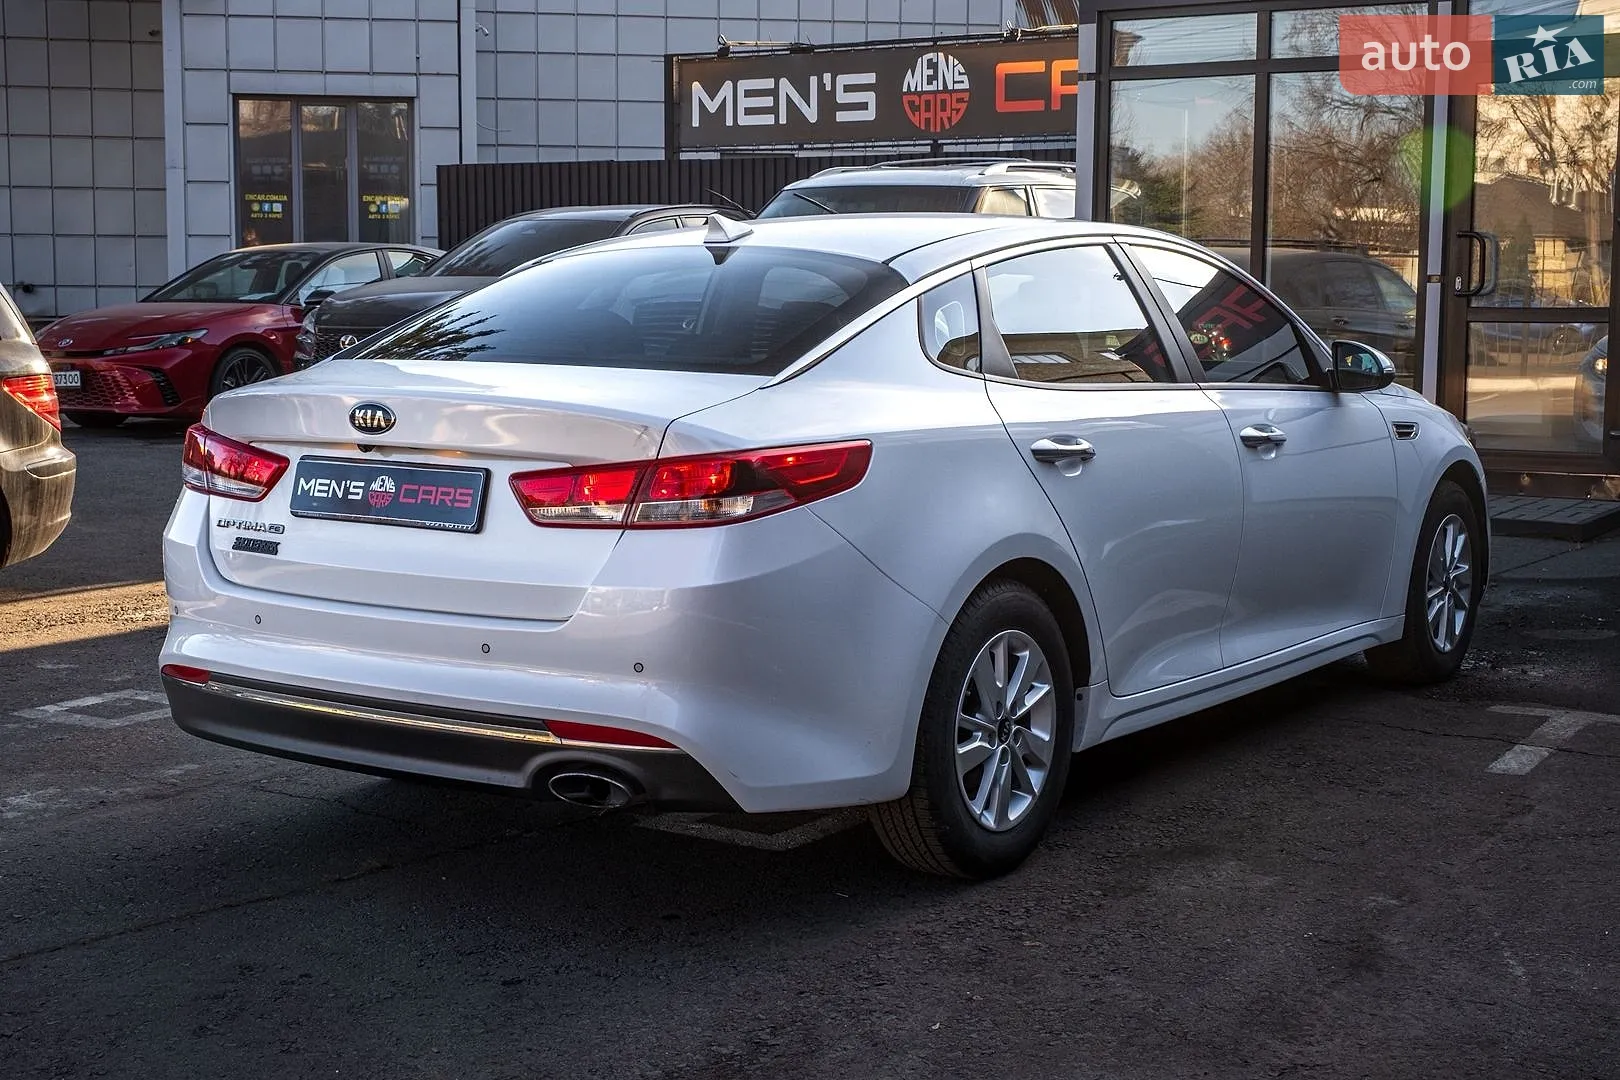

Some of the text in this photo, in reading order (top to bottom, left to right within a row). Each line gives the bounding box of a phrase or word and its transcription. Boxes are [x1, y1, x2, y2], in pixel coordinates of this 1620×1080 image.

[691, 72, 876, 128] MEN'S
[902, 92, 970, 133] CARS
[355, 409, 386, 428] KIA
[297, 477, 474, 509] MEN'S CARS
[216, 519, 267, 533] OPTIMA
